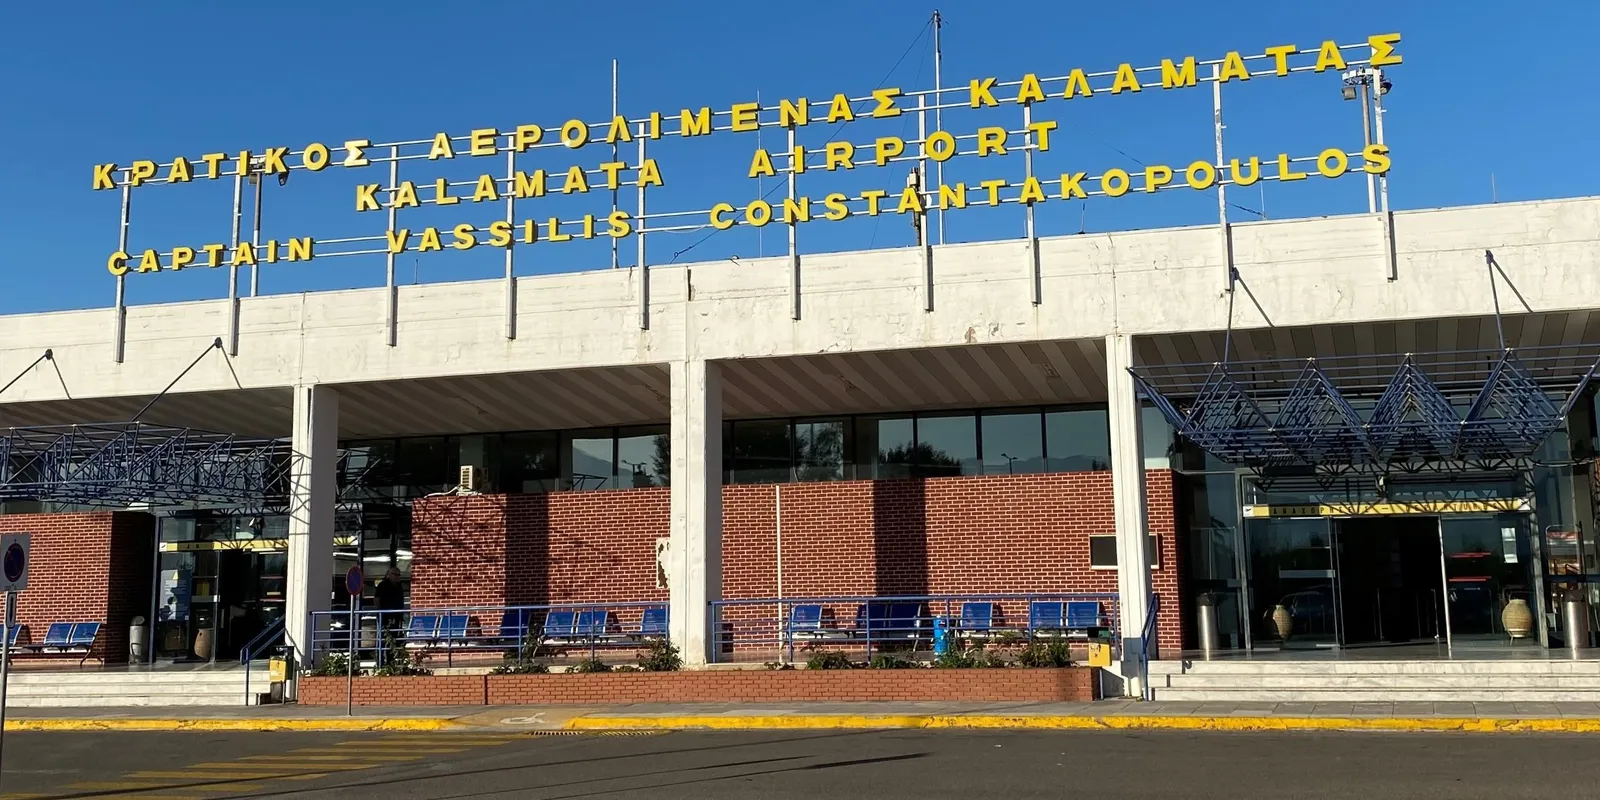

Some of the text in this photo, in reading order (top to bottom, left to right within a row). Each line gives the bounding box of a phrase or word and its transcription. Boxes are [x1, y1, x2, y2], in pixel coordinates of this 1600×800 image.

[94, 33, 1404, 189] ΚΡΑΤΙΚΟΣ ΑΕΡΟΛΙΜΕΝΑΣ ΚΑΛΑΜΑΤΑΣ
[355, 120, 1058, 212] KALAMATA AIRPORT
[108, 144, 1392, 277] CAPTAIN VASSILIS CONSTANTAKOPOULOS
